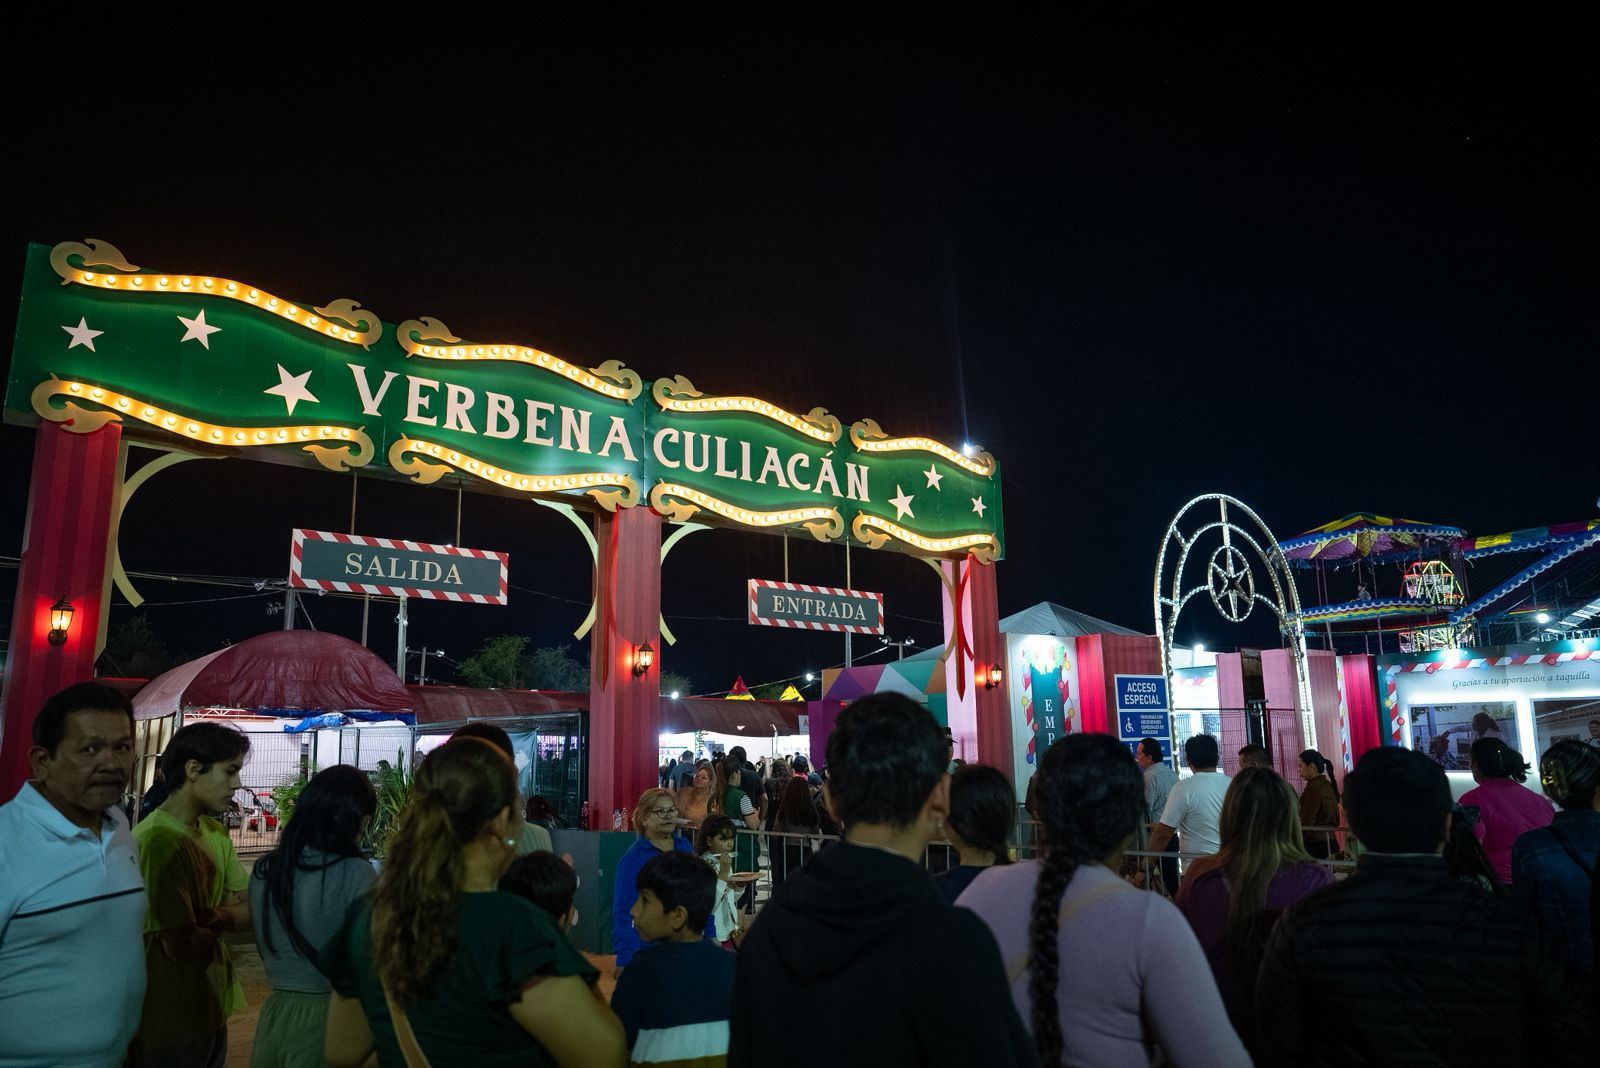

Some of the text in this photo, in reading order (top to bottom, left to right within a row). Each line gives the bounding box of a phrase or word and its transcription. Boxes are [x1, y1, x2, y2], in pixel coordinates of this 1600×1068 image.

[347, 363, 871, 502] VERBENA CULIACÁN
[345, 552, 463, 585] SALIDA
[772, 595, 867, 621] ENTRADA
[1127, 682, 1157, 693] ACCESO
[1452, 679, 1482, 690] Gracias
[1501, 674, 1546, 687] aportación
[1556, 670, 1591, 684] taquilla
[1124, 694, 1162, 705] ESPECIAL
